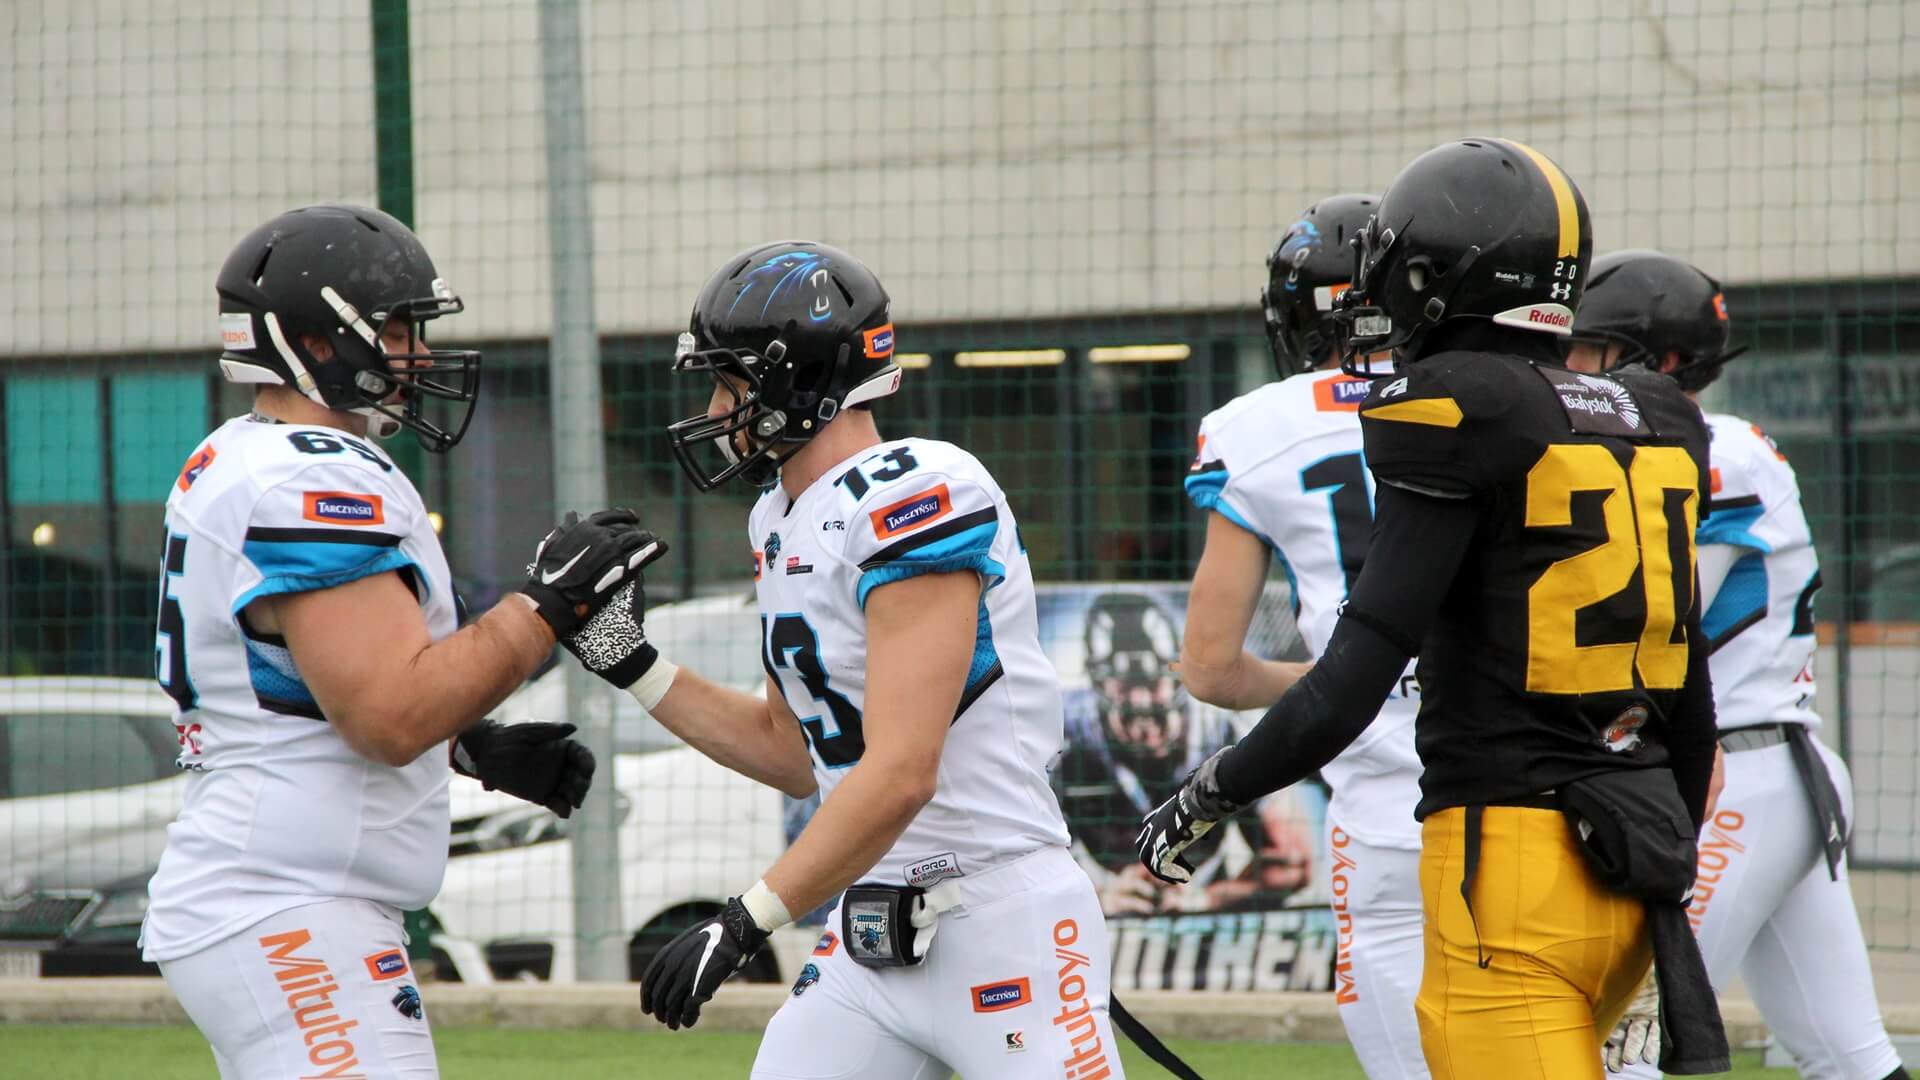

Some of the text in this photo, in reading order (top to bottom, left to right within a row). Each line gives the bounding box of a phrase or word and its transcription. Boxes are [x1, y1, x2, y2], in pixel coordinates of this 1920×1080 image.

[1554, 261, 1577, 280] 20
[1529, 309, 1570, 327] Riddell
[1561, 394, 1615, 415] Białystok
[832, 446, 919, 502] 13
[886, 500, 939, 530] TARCZYŃSKI
[1525, 444, 1699, 695] 20
